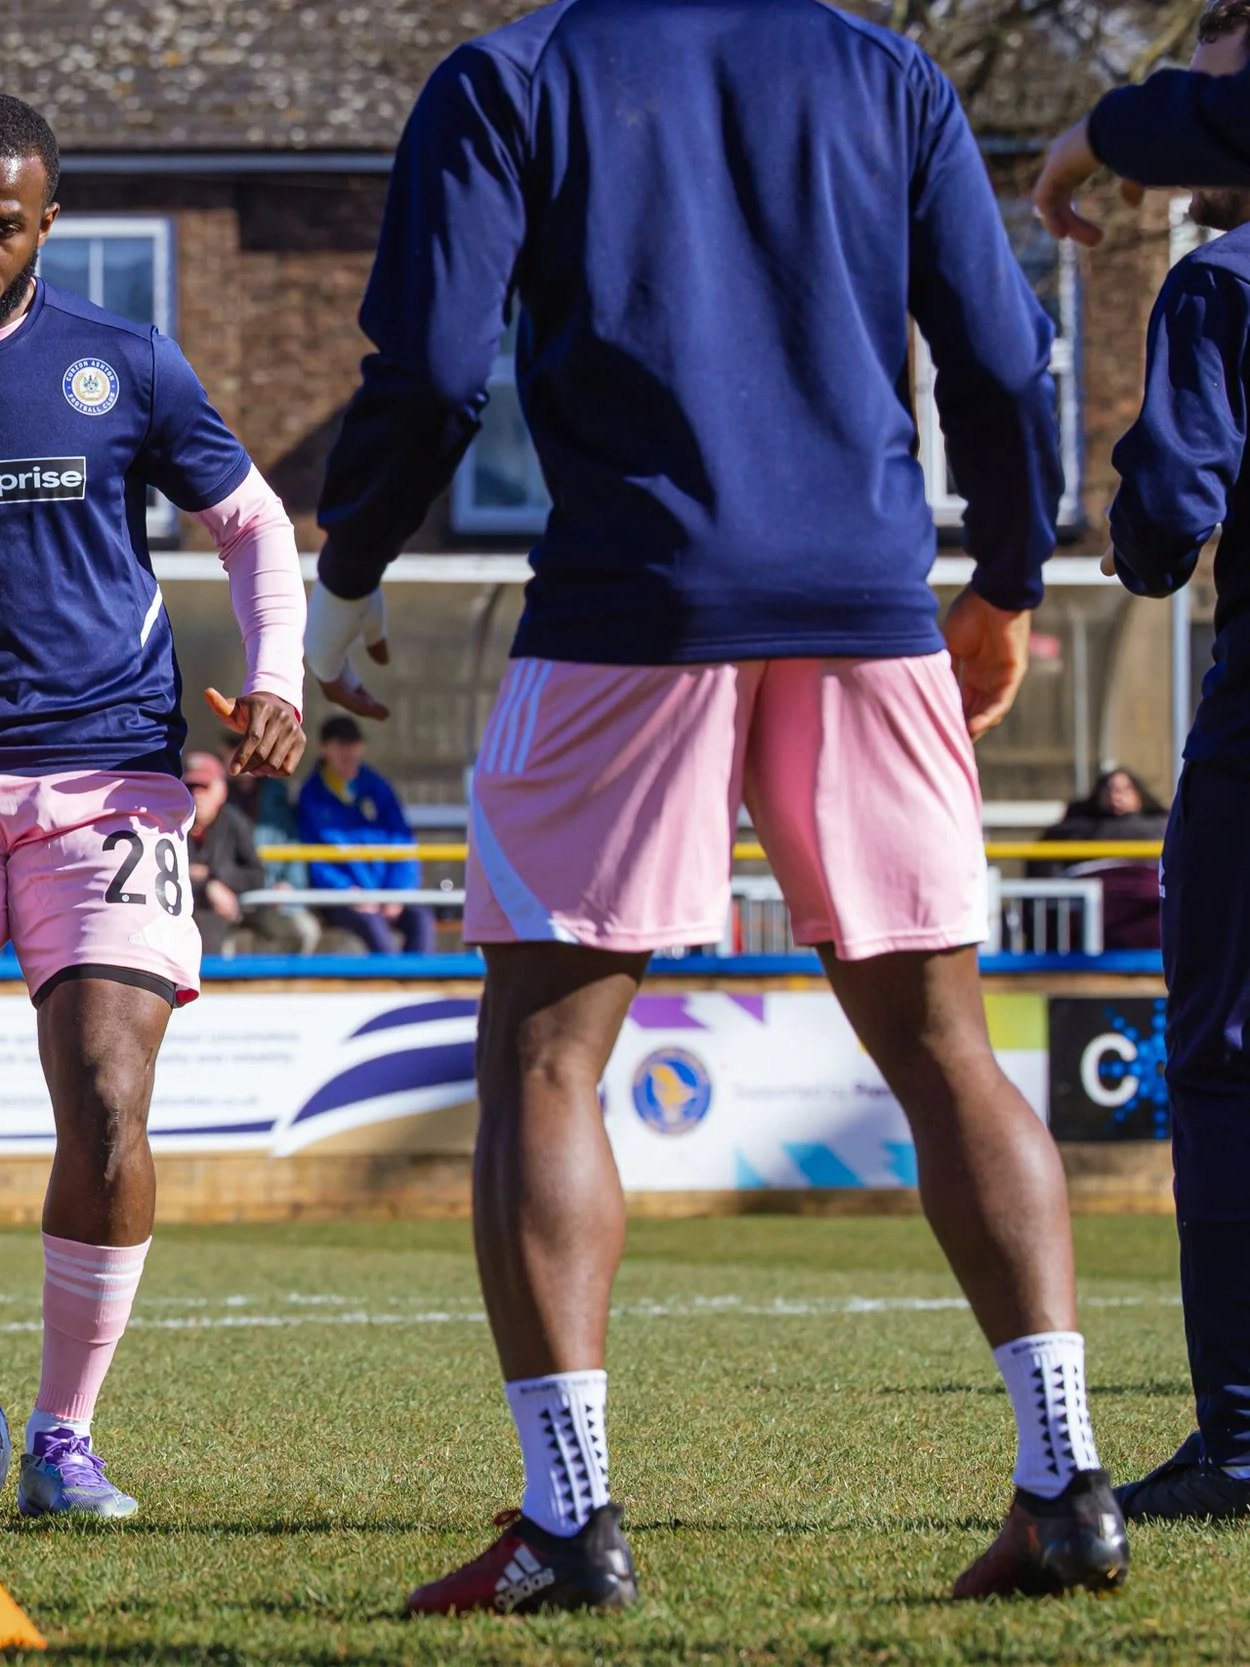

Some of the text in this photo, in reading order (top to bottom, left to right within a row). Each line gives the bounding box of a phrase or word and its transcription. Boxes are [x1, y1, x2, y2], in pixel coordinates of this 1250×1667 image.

[66, 360, 115, 382] CURZON ASHTON
[68, 392, 115, 413] FOOTBALL CLUB
[102, 830, 182, 916] 28
[494, 1567, 555, 1611] adidas
